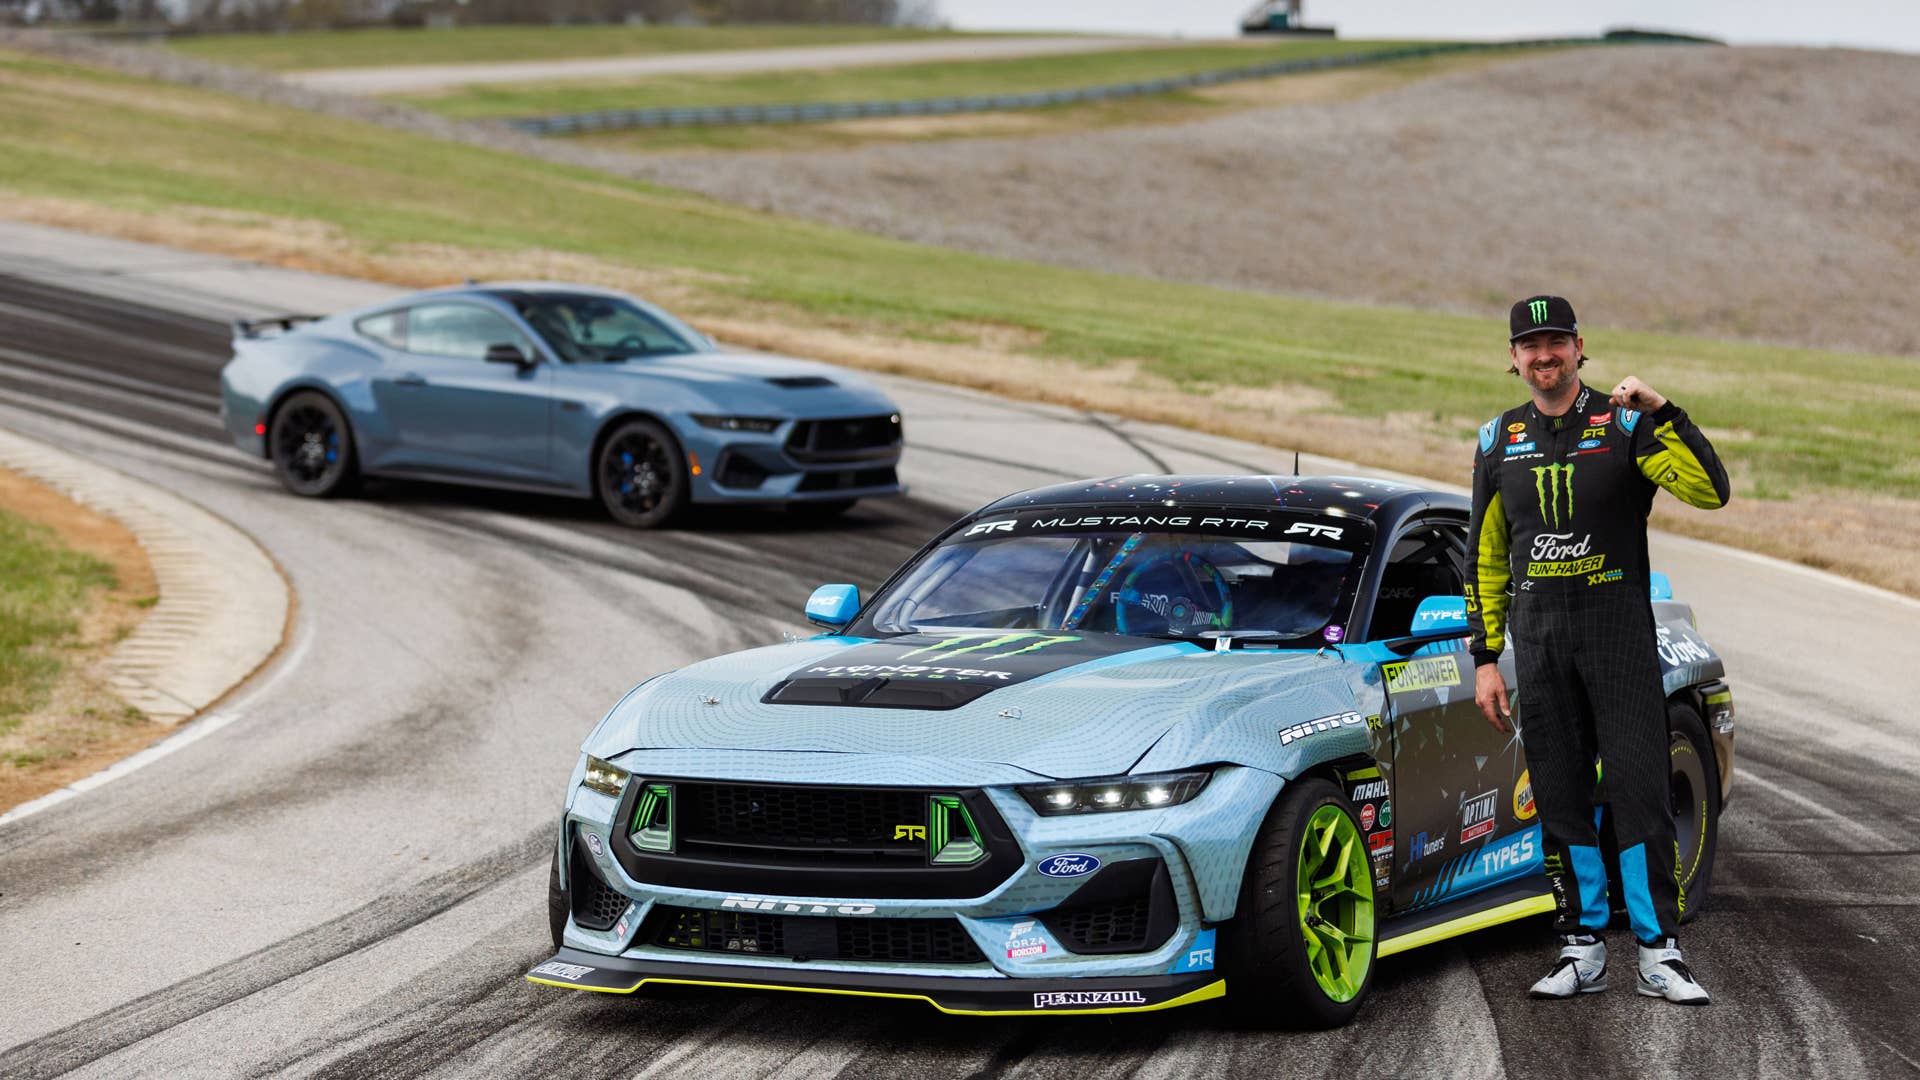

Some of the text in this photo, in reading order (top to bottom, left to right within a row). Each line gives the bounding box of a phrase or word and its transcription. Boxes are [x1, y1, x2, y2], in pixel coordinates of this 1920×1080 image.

[1031, 516, 1270, 530] MUSTANG RTR
[1530, 532, 1591, 560] Ford
[1528, 559, 1600, 574] FUN-HAVER
[1420, 611, 1467, 621] TYPE
[806, 664, 1013, 680] MONSTER
[826, 672, 972, 681] ENERGY
[1387, 660, 1458, 687] FUN-HAVER
[1278, 710, 1361, 746] NITTO
[1464, 796, 1495, 826] OPTIMA
[1410, 831, 1445, 862] HP tuners
[1049, 857, 1089, 874] Ford
[721, 896, 876, 914] NITTO
[1005, 936, 1046, 950] FORZA
[1011, 946, 1044, 958] HORIZON
[1033, 990, 1146, 1008] PENNZOIL
